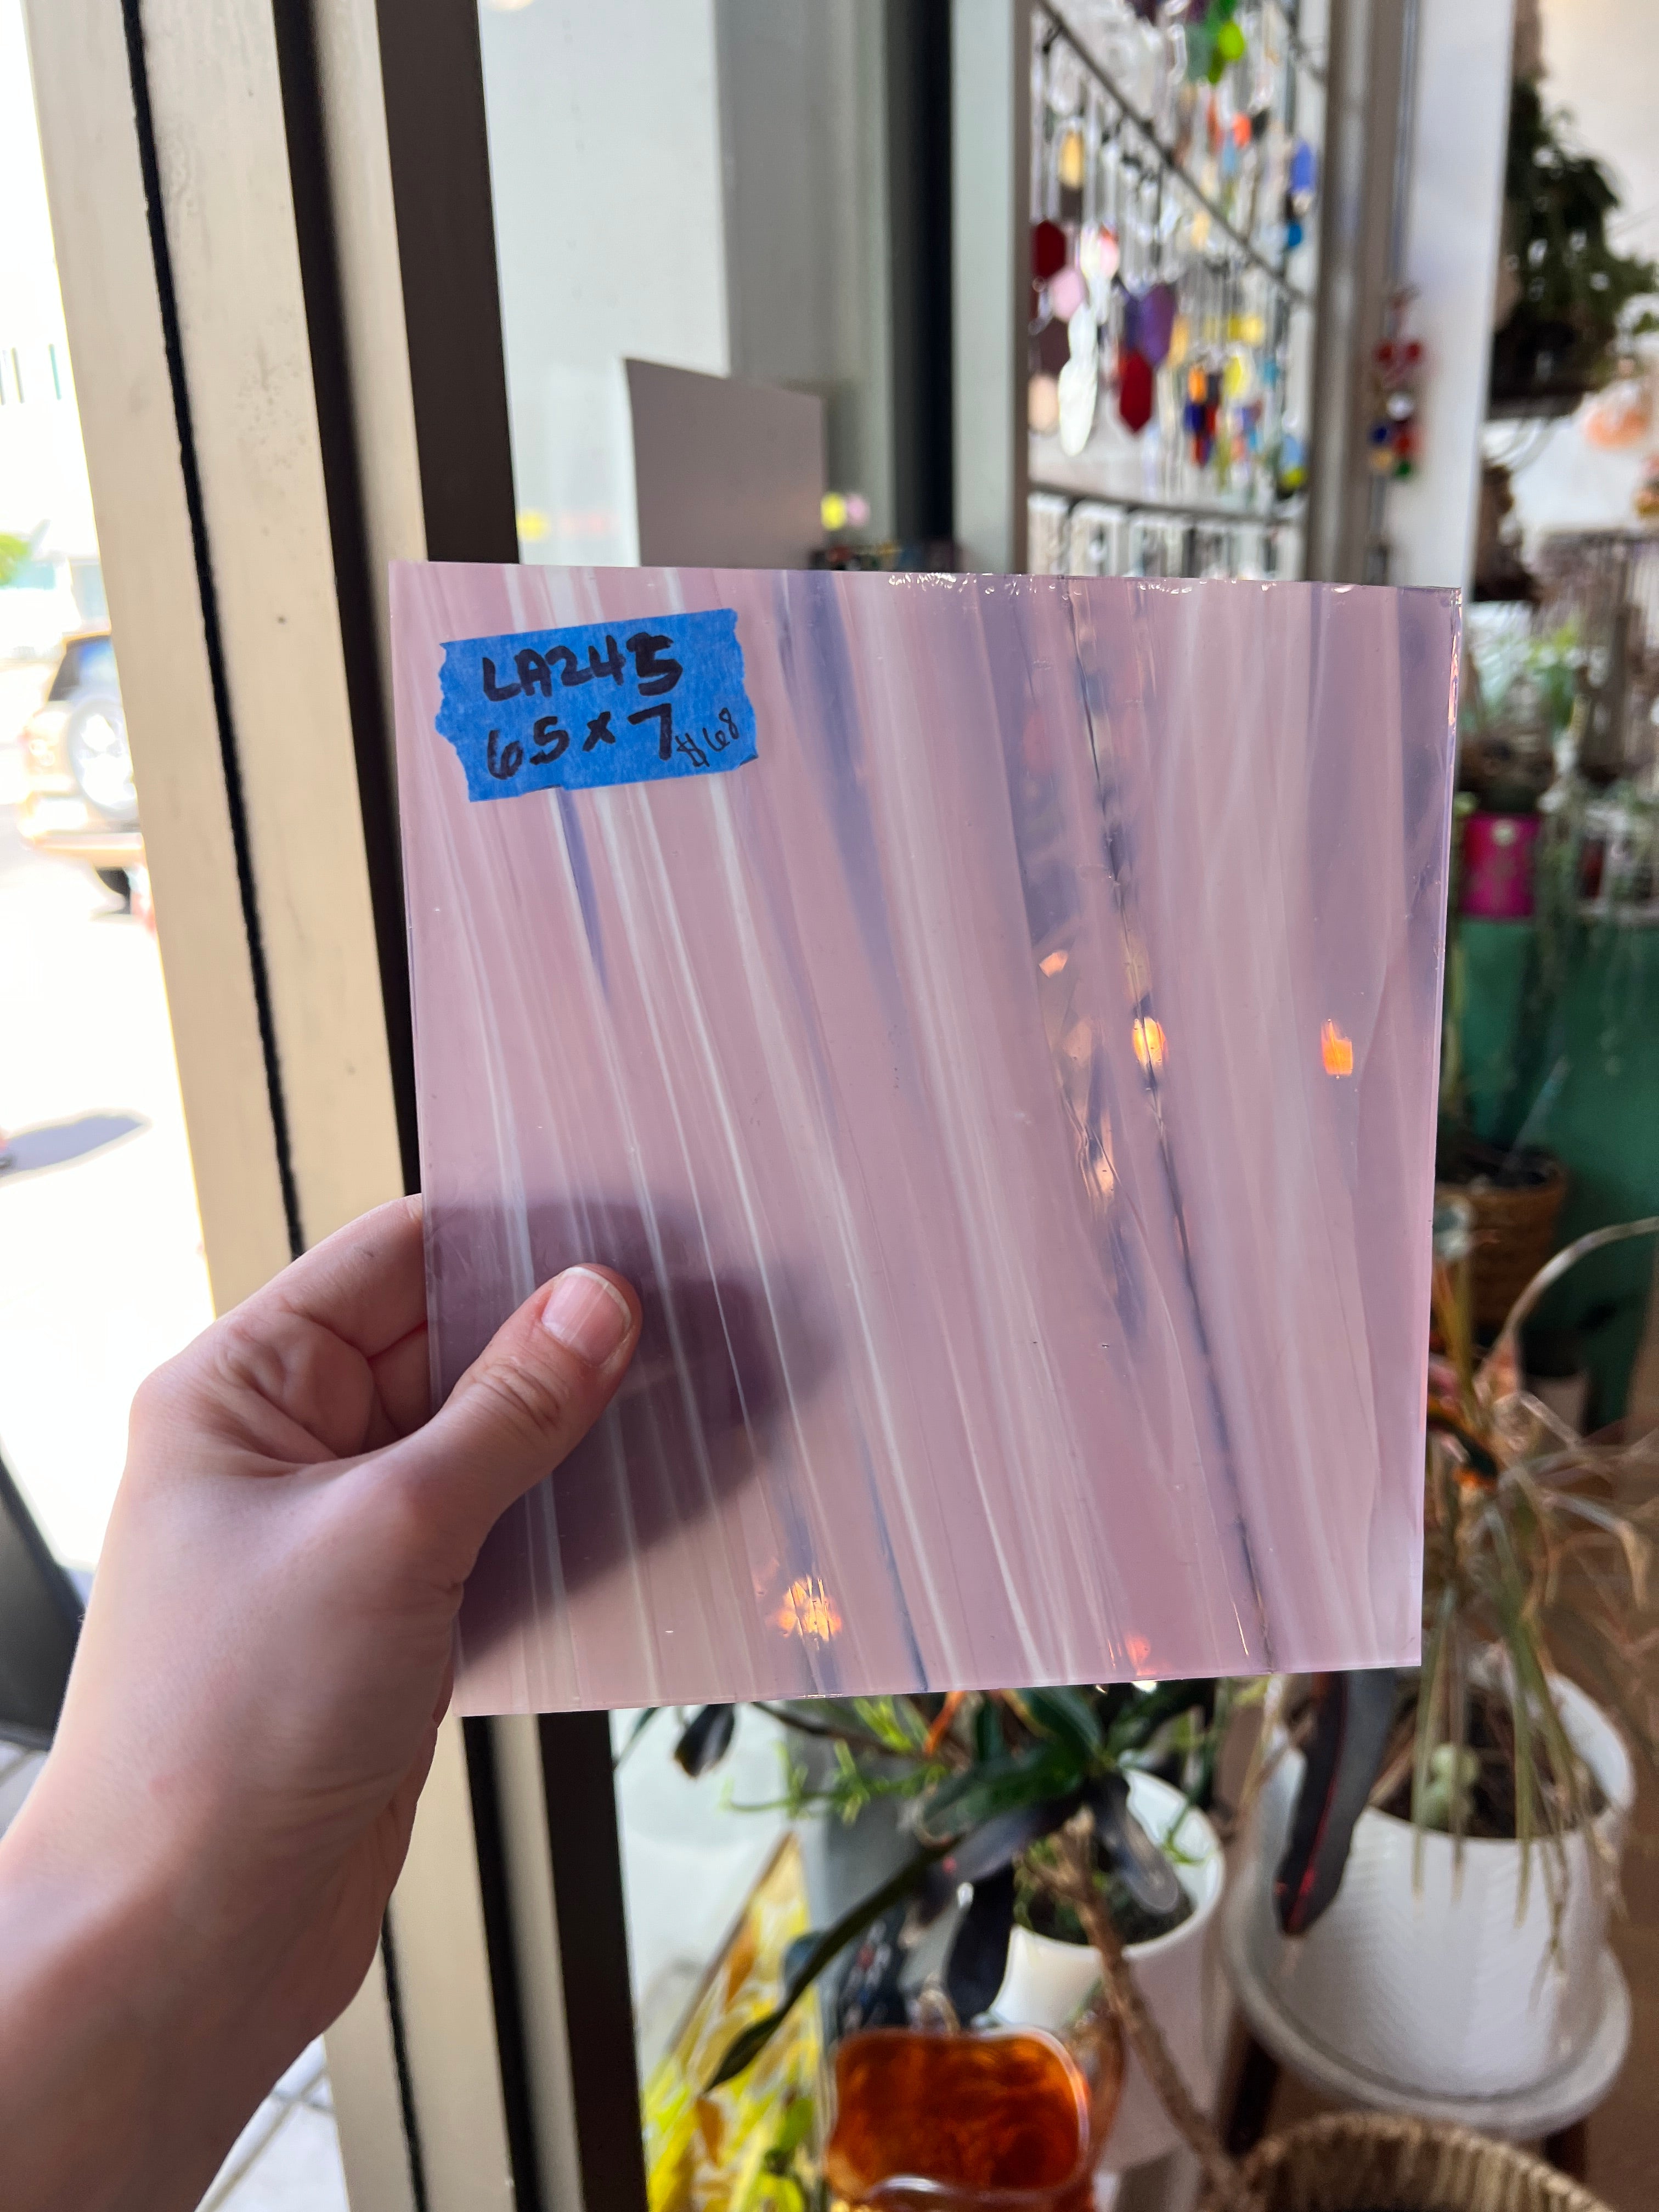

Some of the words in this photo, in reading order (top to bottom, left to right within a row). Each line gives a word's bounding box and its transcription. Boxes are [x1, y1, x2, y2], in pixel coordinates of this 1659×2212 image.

[482, 632, 683, 702] LA245
[627, 703, 672, 761] 7
[675, 707, 740, 768] $68
